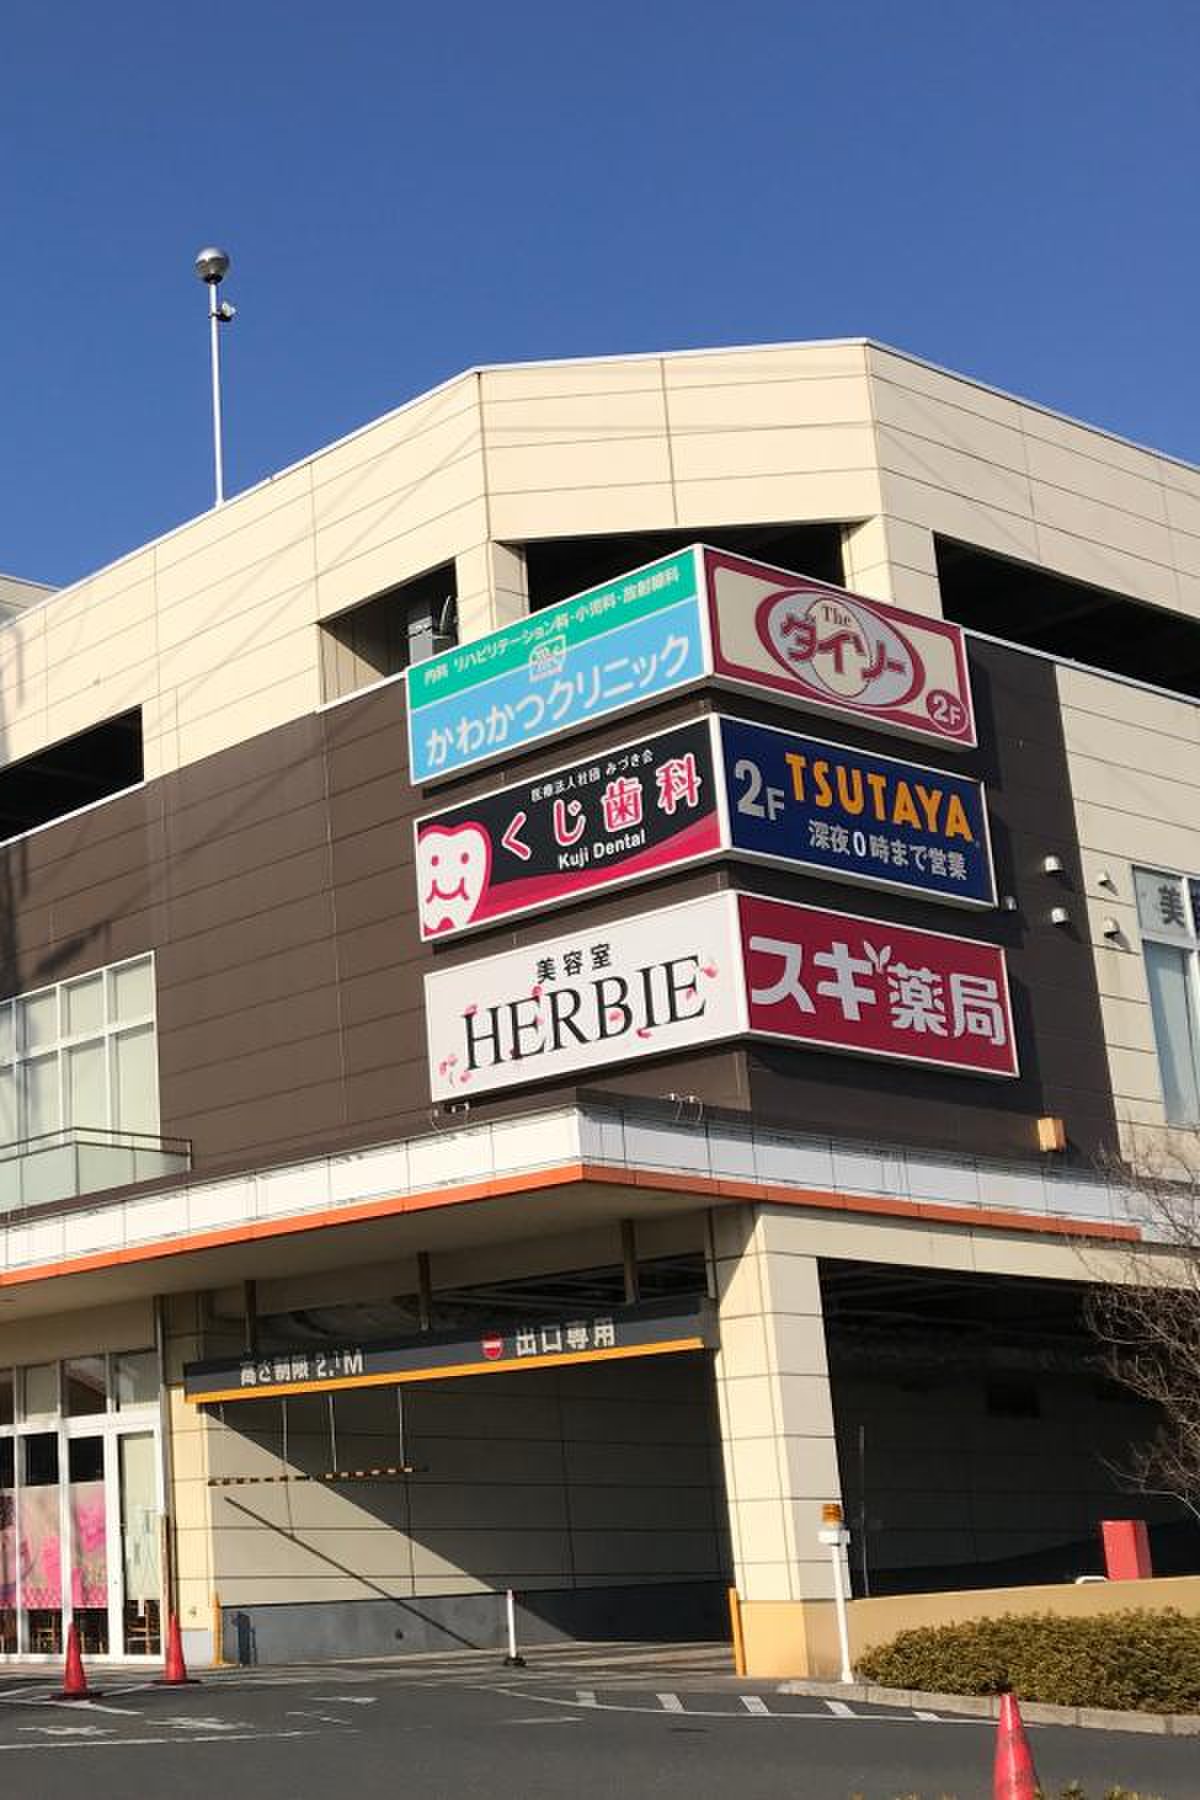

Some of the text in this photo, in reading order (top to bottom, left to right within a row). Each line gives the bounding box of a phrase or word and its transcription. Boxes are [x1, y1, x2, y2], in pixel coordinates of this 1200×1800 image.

[822, 606, 851, 626] The
[426, 633, 690, 767] かわかつクリニック
[932, 694, 961, 726] 2F
[530, 750, 654, 802] 医療法人社団 みづき会
[735, 752, 974, 842] 2F TSUTAYA
[501, 752, 702, 862] くじ歯科
[558, 829, 646, 870] Kuji Dental
[808, 819, 968, 881] 深夜0時まで営業
[536, 943, 612, 984] 美容室
[749, 936, 1007, 1046] スギ薬局
[461, 955, 706, 1071] HERBIE
[515, 1319, 616, 1357] 出口専用
